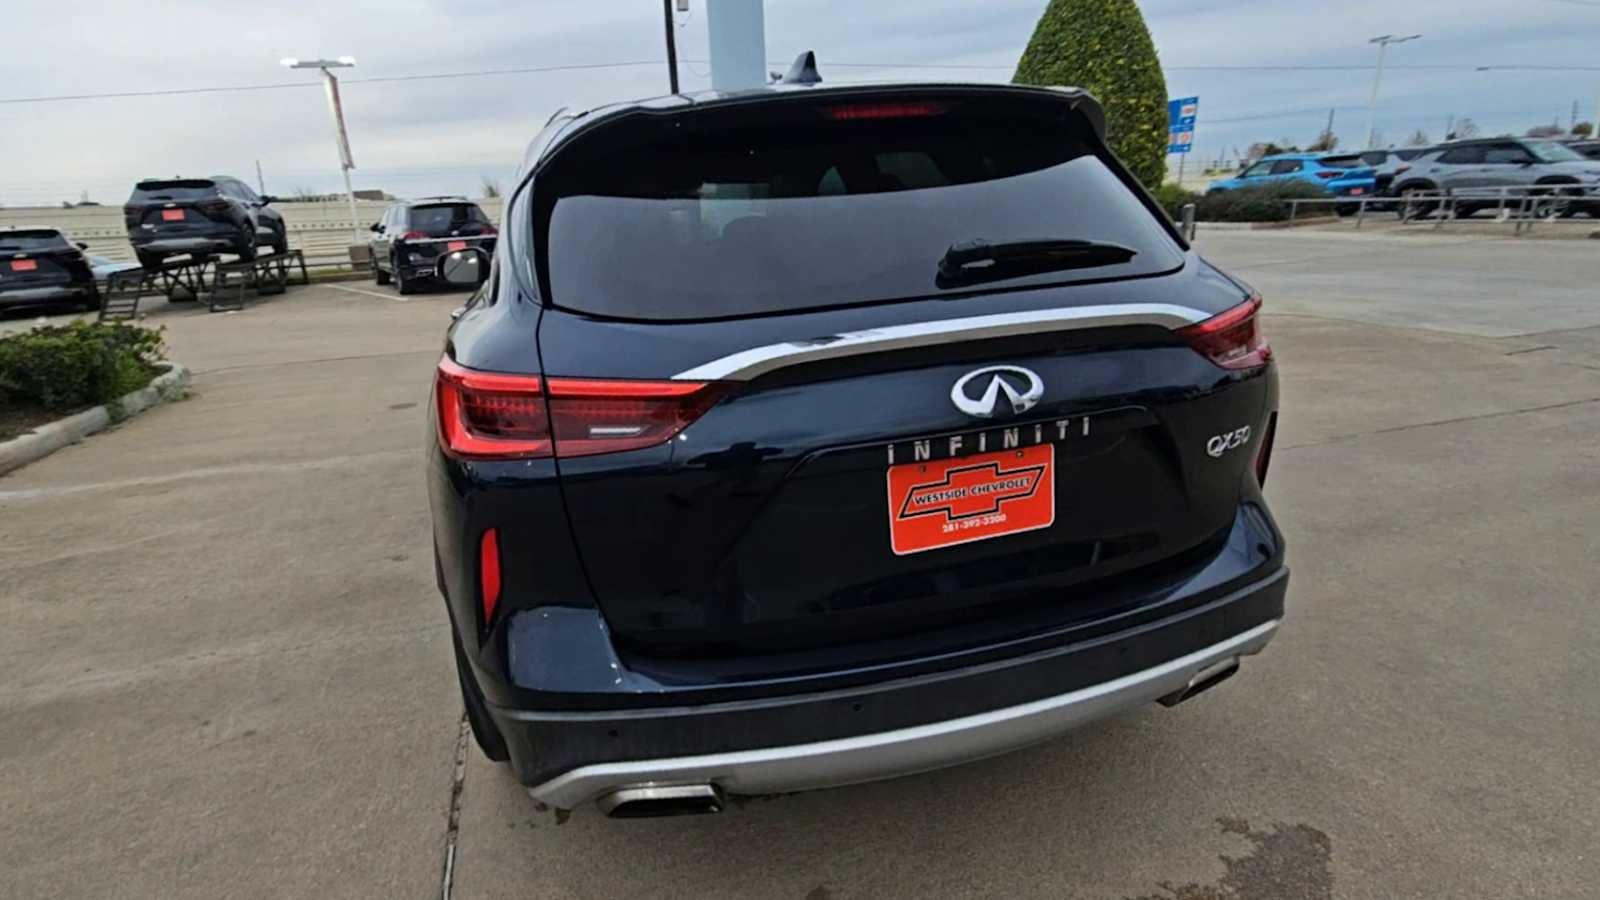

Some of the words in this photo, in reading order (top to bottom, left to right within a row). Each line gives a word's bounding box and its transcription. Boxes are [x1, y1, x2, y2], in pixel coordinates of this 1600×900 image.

[888, 416, 1090, 464] INFINITI
[1207, 425, 1250, 457] QX50
[913, 488, 967, 504] WESTSIDE
[970, 478, 1030, 496] CHEVROLET
